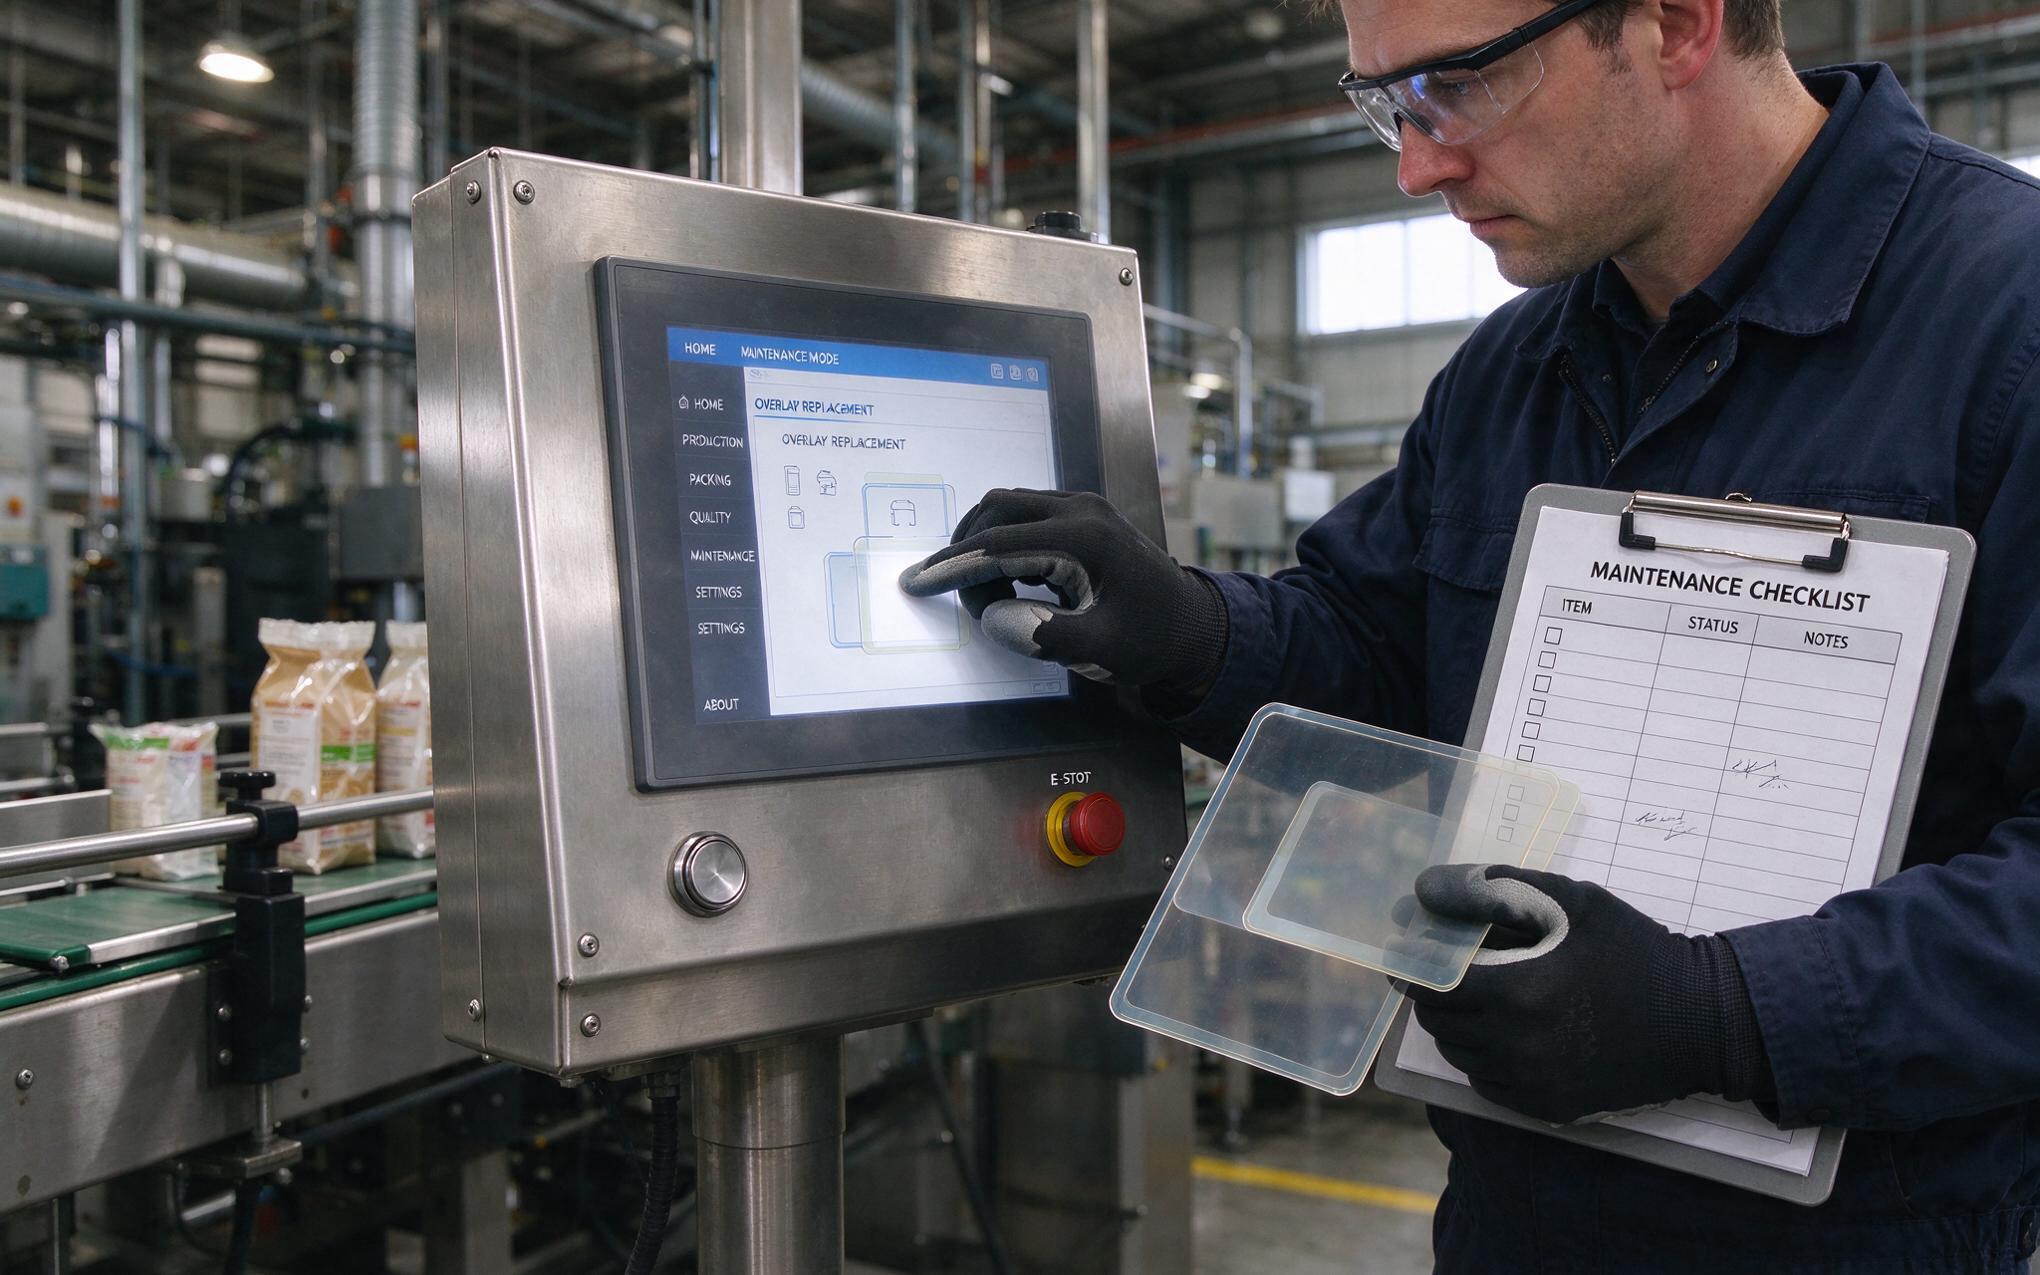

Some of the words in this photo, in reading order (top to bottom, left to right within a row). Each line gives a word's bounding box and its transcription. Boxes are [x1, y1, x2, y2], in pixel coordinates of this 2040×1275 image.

[684, 342, 716, 356] HOME
[808, 352, 839, 365] MODE
[694, 398, 724, 411] HOME
[755, 398, 799, 412] OVERLAY
[782, 433, 828, 447] OVERLAY
[831, 435, 906, 450] REPLACEMENT
[689, 511, 731, 525] QUALITY
[696, 586, 742, 599] SETTINGS
[1590, 561, 1743, 597] MAINTENANCE
[1749, 580, 1871, 613] CHECKLIST
[1562, 598, 1593, 615] ITEM
[698, 622, 745, 635] SETTINGS
[1687, 616, 1739, 634] STATUS
[1803, 630, 1848, 649] NOTES
